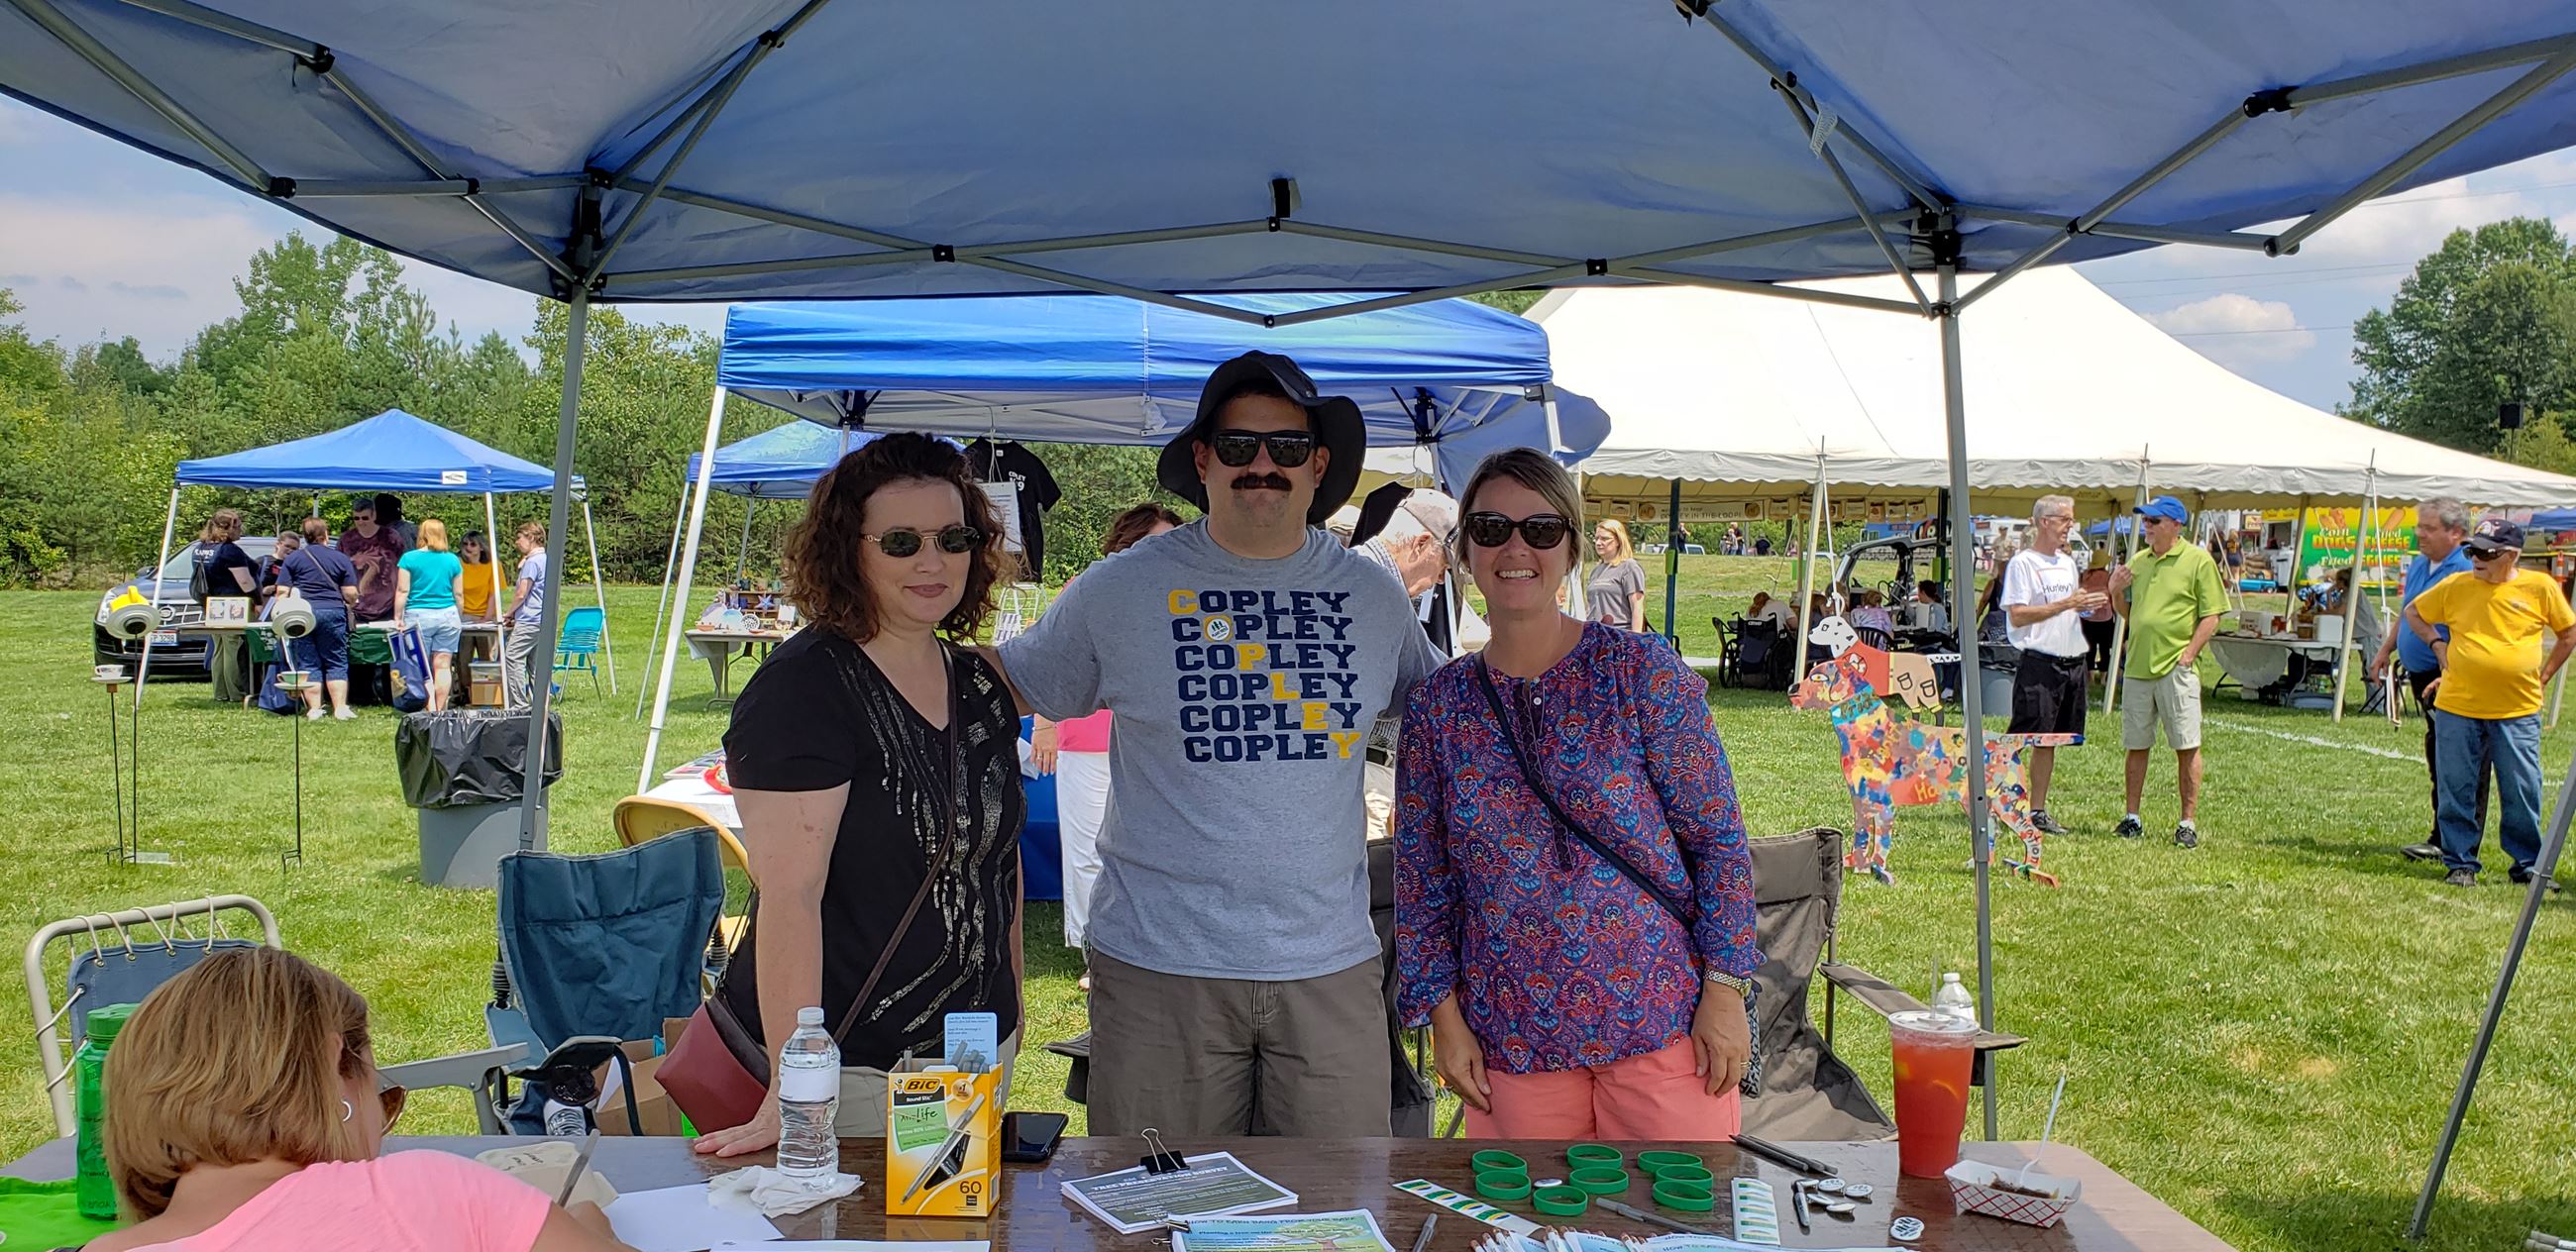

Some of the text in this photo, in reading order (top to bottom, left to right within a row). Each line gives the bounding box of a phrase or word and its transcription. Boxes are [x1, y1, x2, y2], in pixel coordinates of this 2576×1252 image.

[2312, 535, 2356, 549] DOGS
[1167, 589, 1350, 615] COPLEY
[1175, 644, 1356, 672] COPLEY
[1177, 673, 1358, 701] COPLEY
[1179, 702, 1362, 733] COPLEY
[1183, 732, 1361, 763] COPLEY
[907, 1080, 937, 1091] BIC
[960, 1181, 982, 1195] 60
[1120, 1174, 1192, 1187] PRESERVATION
[1193, 1166, 1229, 1177] SURVEY
